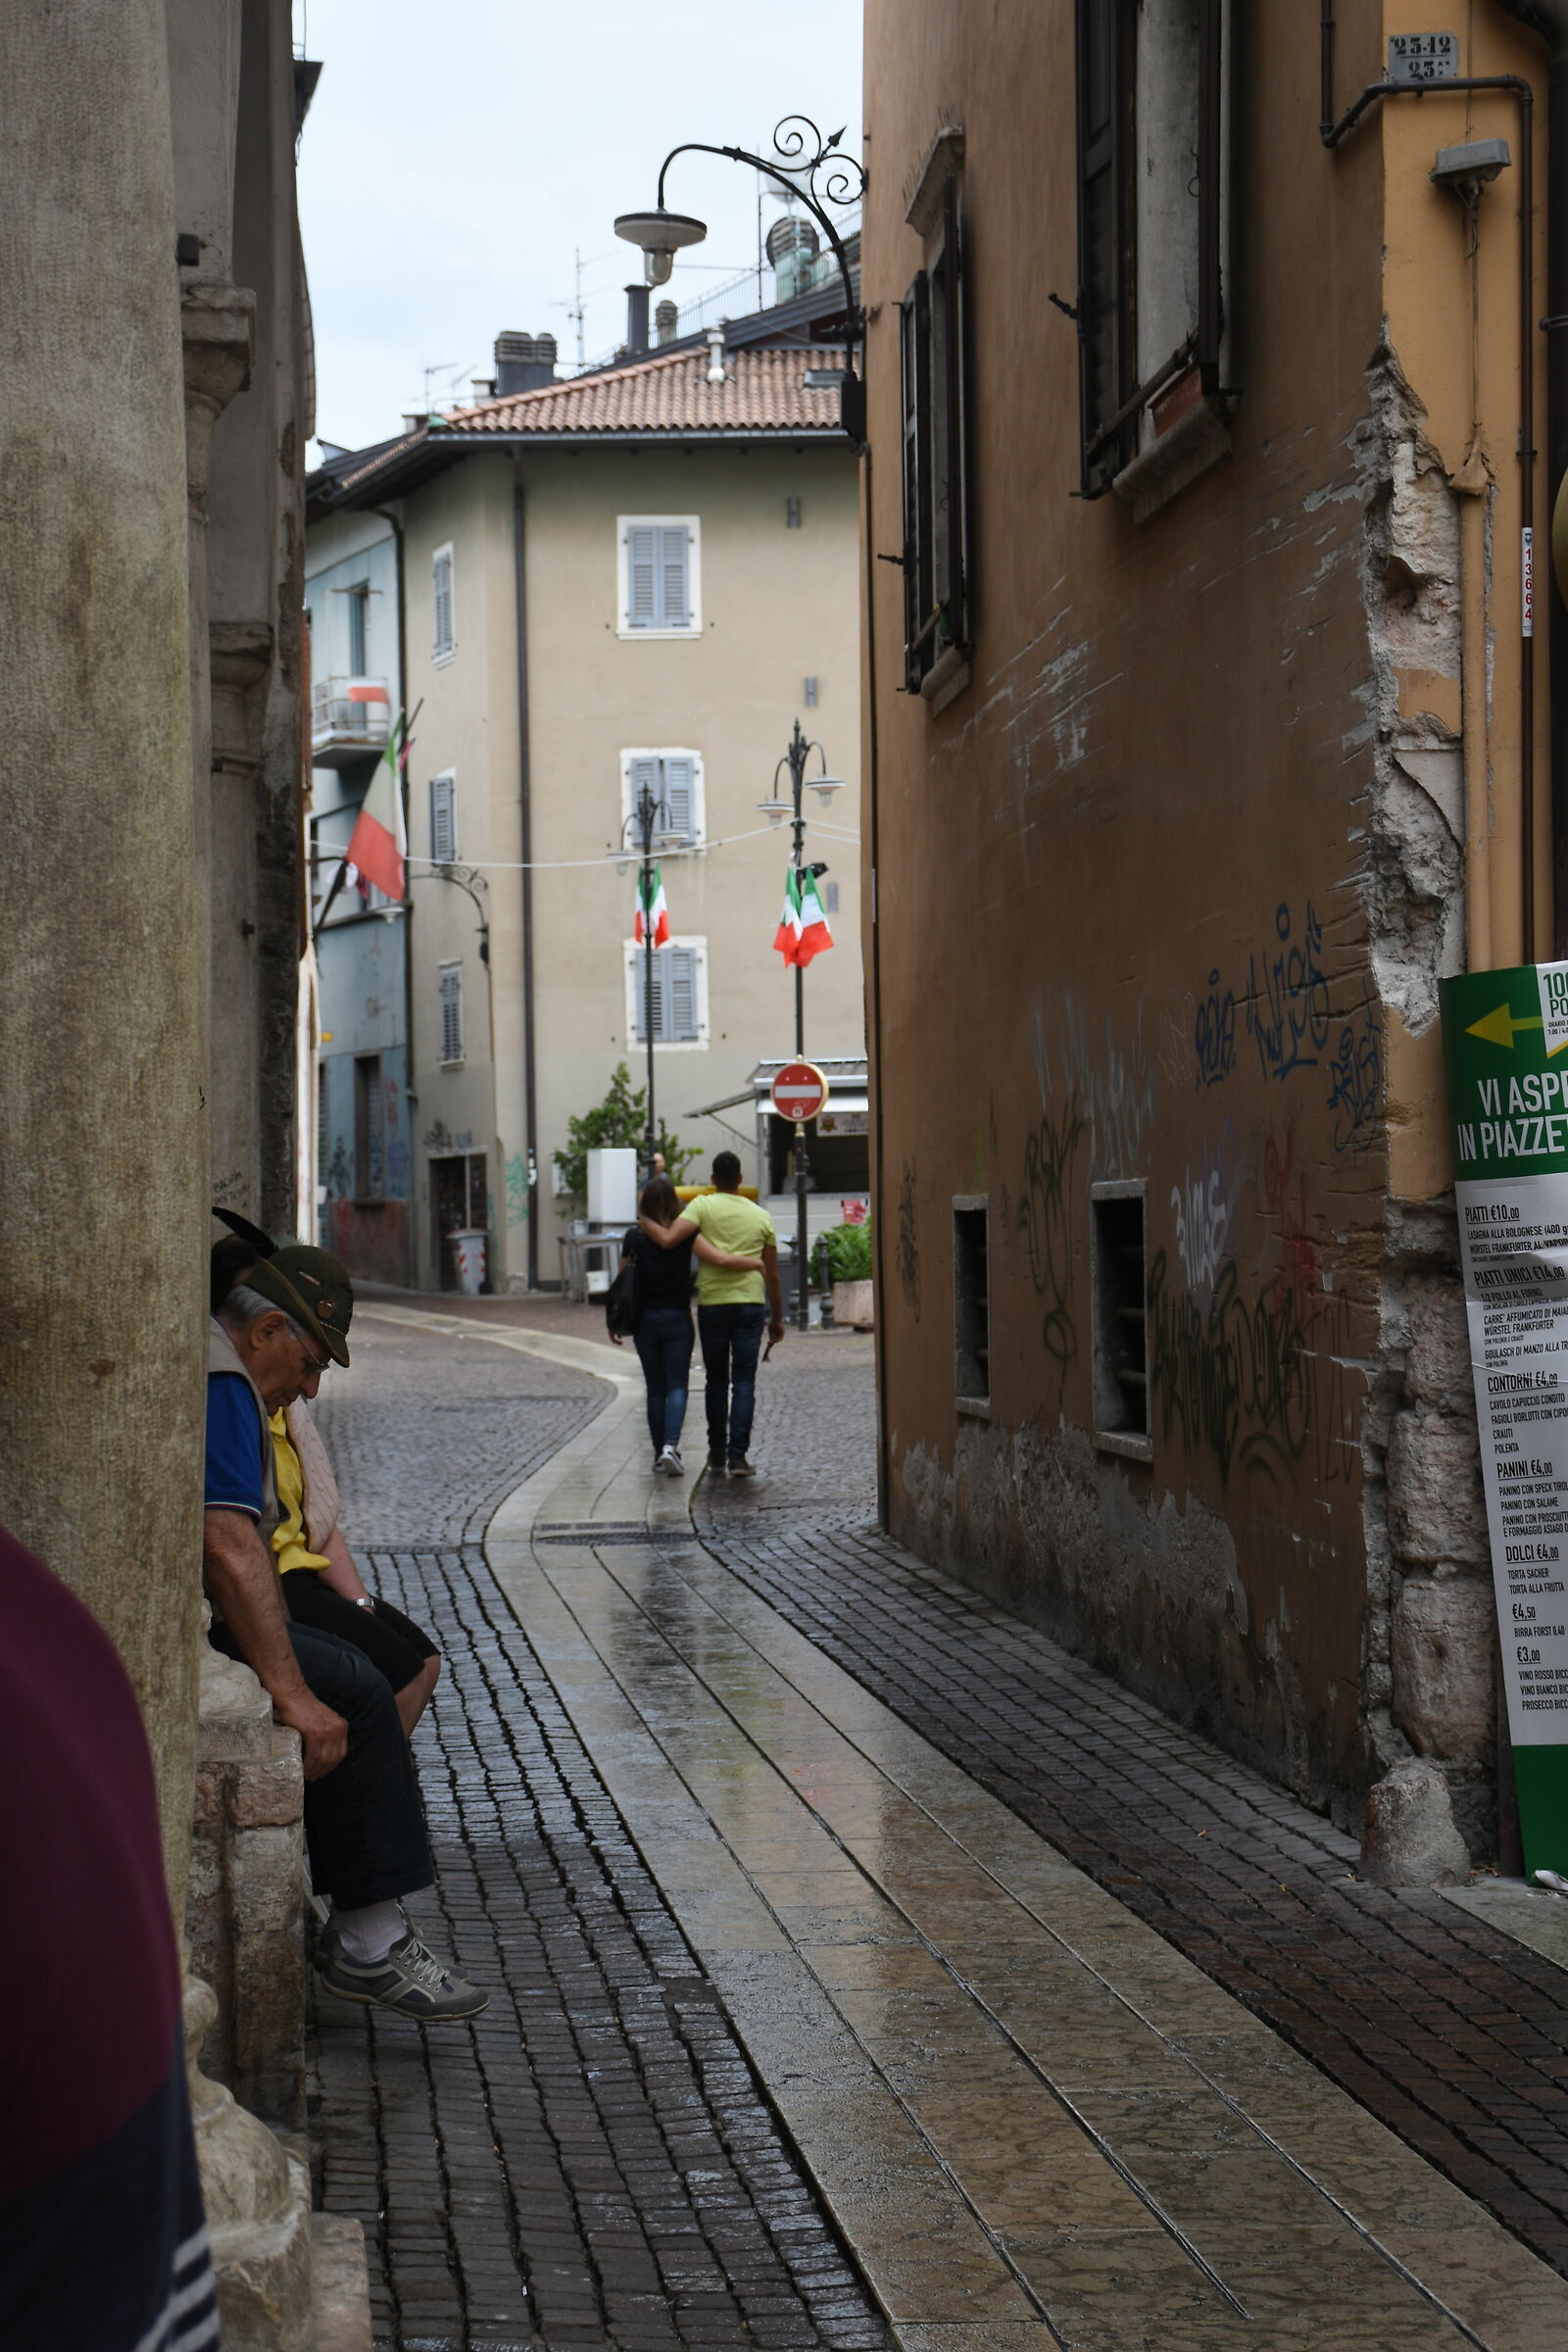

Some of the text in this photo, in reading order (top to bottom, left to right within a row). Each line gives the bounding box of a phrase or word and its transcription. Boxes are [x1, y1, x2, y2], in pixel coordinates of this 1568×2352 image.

[1543, 971, 1568, 998] 10
[1477, 1079, 1501, 1116] VI
[1458, 1113, 1568, 1161] IN PIAZZE
[1465, 1204, 1520, 1222] PIATTI €10.00
[1491, 1228, 1505, 1238] ALLA
[1506, 1225, 1542, 1238] BOLOGNESE
[1492, 1242, 1532, 1254] FRANKFURTER
[1533, 1240, 1543, 1250] AL
[1474, 1265, 1565, 1287] PIATTI UNICI €14.00
[1492, 1290, 1511, 1301] POLLO
[1512, 1290, 1521, 1299] AL
[1506, 1311, 1543, 1323] AFFUMICATO
[1544, 1310, 1550, 1318] DI
[1513, 1320, 1554, 1333] FRANKFURTER
[1516, 1346, 1521, 1356] DI
[1523, 1344, 1543, 1354] MANZO
[1545, 1342, 1560, 1352] ALLA
[1488, 1371, 1558, 1392] CONTORNI €4.00
[1490, 1399, 1511, 1410] CAVOLO
[1541, 1393, 1565, 1404] CONDITO
[1491, 1415, 1512, 1425] FAGIOLI
[1514, 1411, 1540, 1422] BORLOTTI
[1541, 1409, 1553, 1419] CON
[1493, 1428, 1513, 1439] CRAUTI
[1494, 1443, 1519, 1454] POLENTA
[1497, 1459, 1553, 1478] PANINI €4.00
[1499, 1485, 1520, 1496] PANINO
[1522, 1484, 1534, 1494] CON
[1534, 1483, 1553, 1493] SPECK
[1501, 1497, 1559, 1511] PANINO CON SALAME
[1502, 1515, 1523, 1525] PANINO
[1525, 1514, 1537, 1524] CON
[1503, 1527, 1508, 1537] E
[1509, 1525, 1542, 1536] FORMAGGIO
[1506, 1543, 1559, 1562] DOLCI €4.00
[1508, 1568, 1550, 1579] TORTA SACHER
[1509, 1582, 1565, 1595] TORTA ALLA FRUTTA
[1513, 1603, 1536, 1619] €4.50
[1514, 1628, 1533, 1637] BIRRA
[1534, 1626, 1552, 1636] FORST
[1517, 1646, 1540, 1662] €3.00
[1519, 1670, 1533, 1680] VINO
[1534, 1670, 1554, 1680] ROSSO
[1520, 1685, 1535, 1695] VINO
[1536, 1685, 1558, 1695] BIANCO
[1522, 1700, 1553, 1710] PROSECCO
